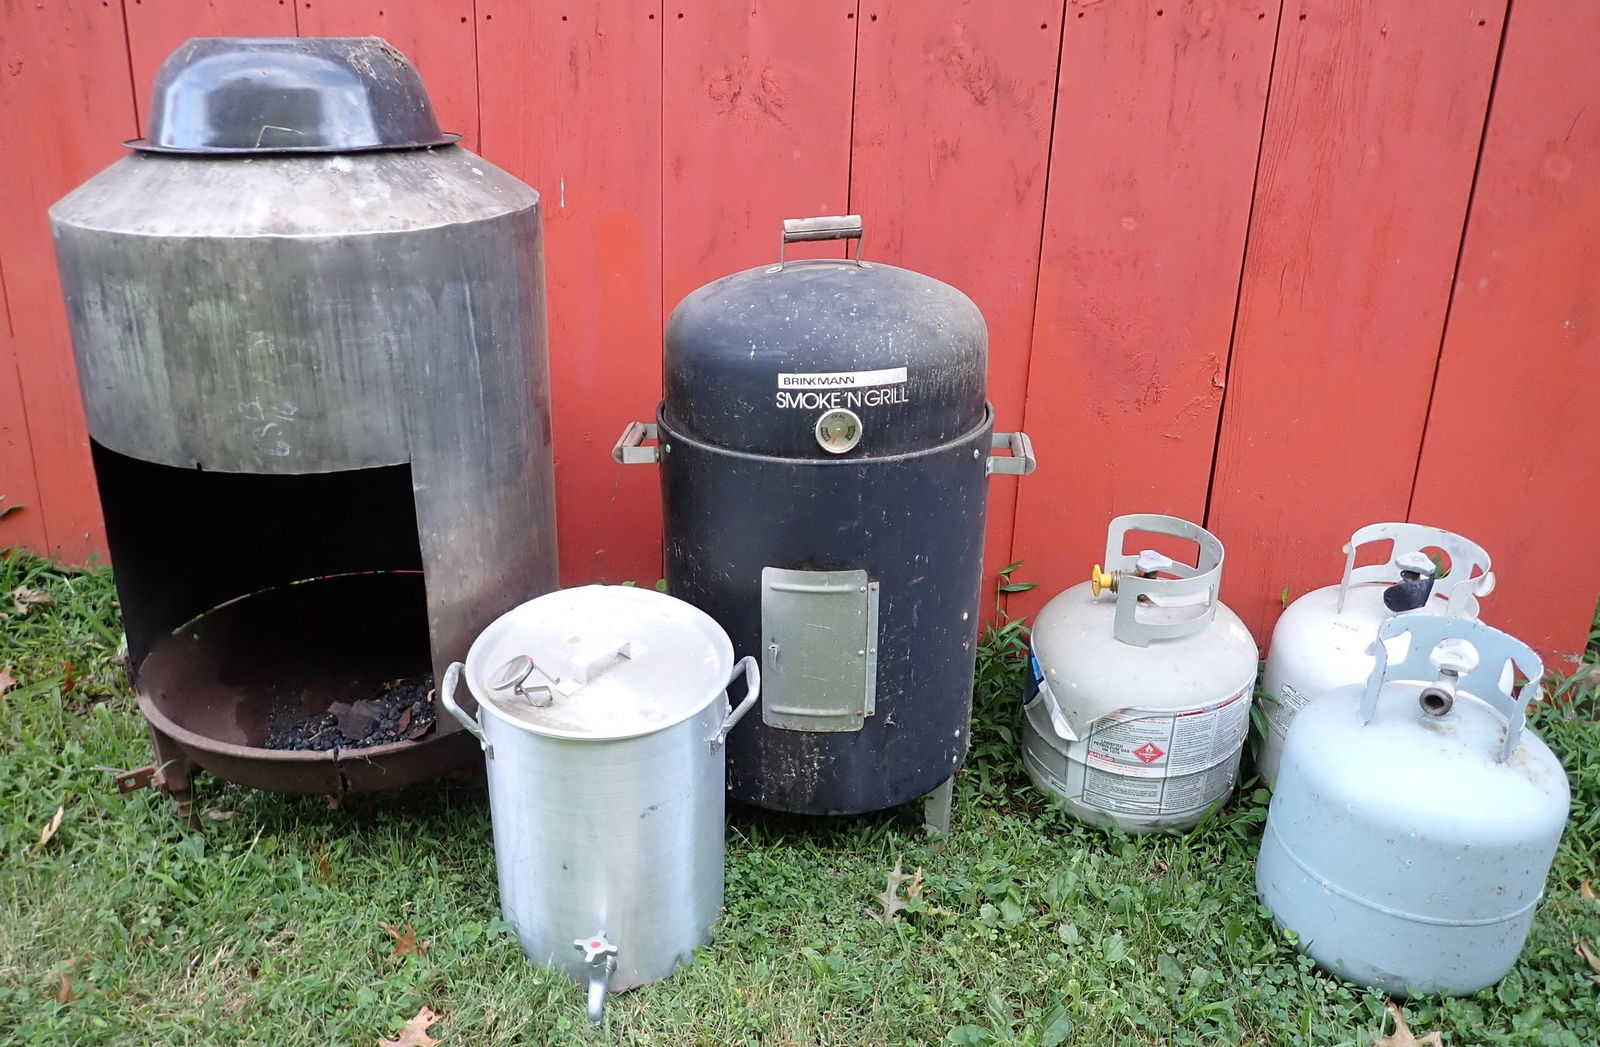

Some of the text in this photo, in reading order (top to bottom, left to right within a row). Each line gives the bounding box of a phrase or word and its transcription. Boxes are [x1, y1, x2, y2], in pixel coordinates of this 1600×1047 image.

[783, 376, 855, 386] BRINKMANN
[776, 391, 841, 409] SMOKE
[864, 386, 909, 407] GRILL
